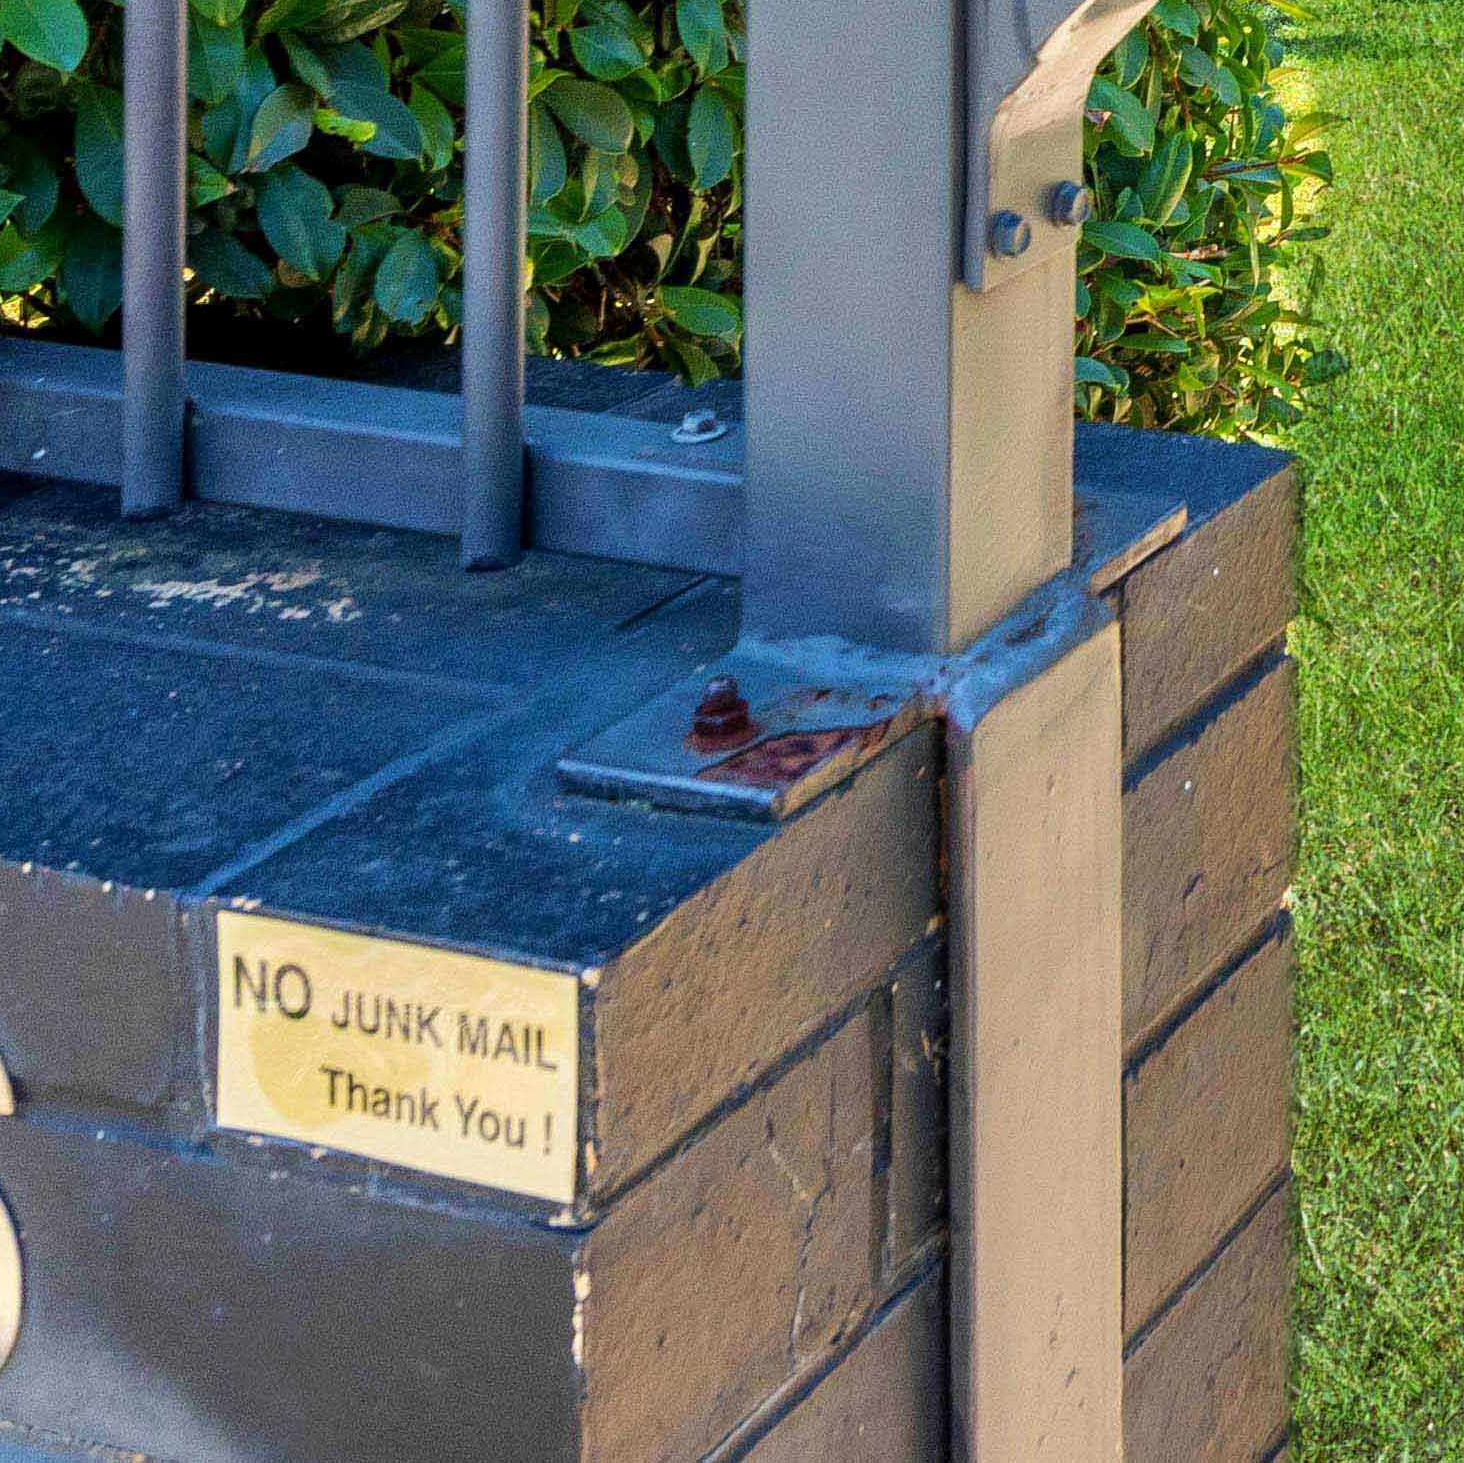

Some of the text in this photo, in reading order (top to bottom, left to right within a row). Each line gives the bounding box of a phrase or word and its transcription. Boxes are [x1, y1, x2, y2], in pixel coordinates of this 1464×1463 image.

[231, 954, 558, 1071] NO JUNK MAIL
[321, 1064, 441, 1131] Thank
